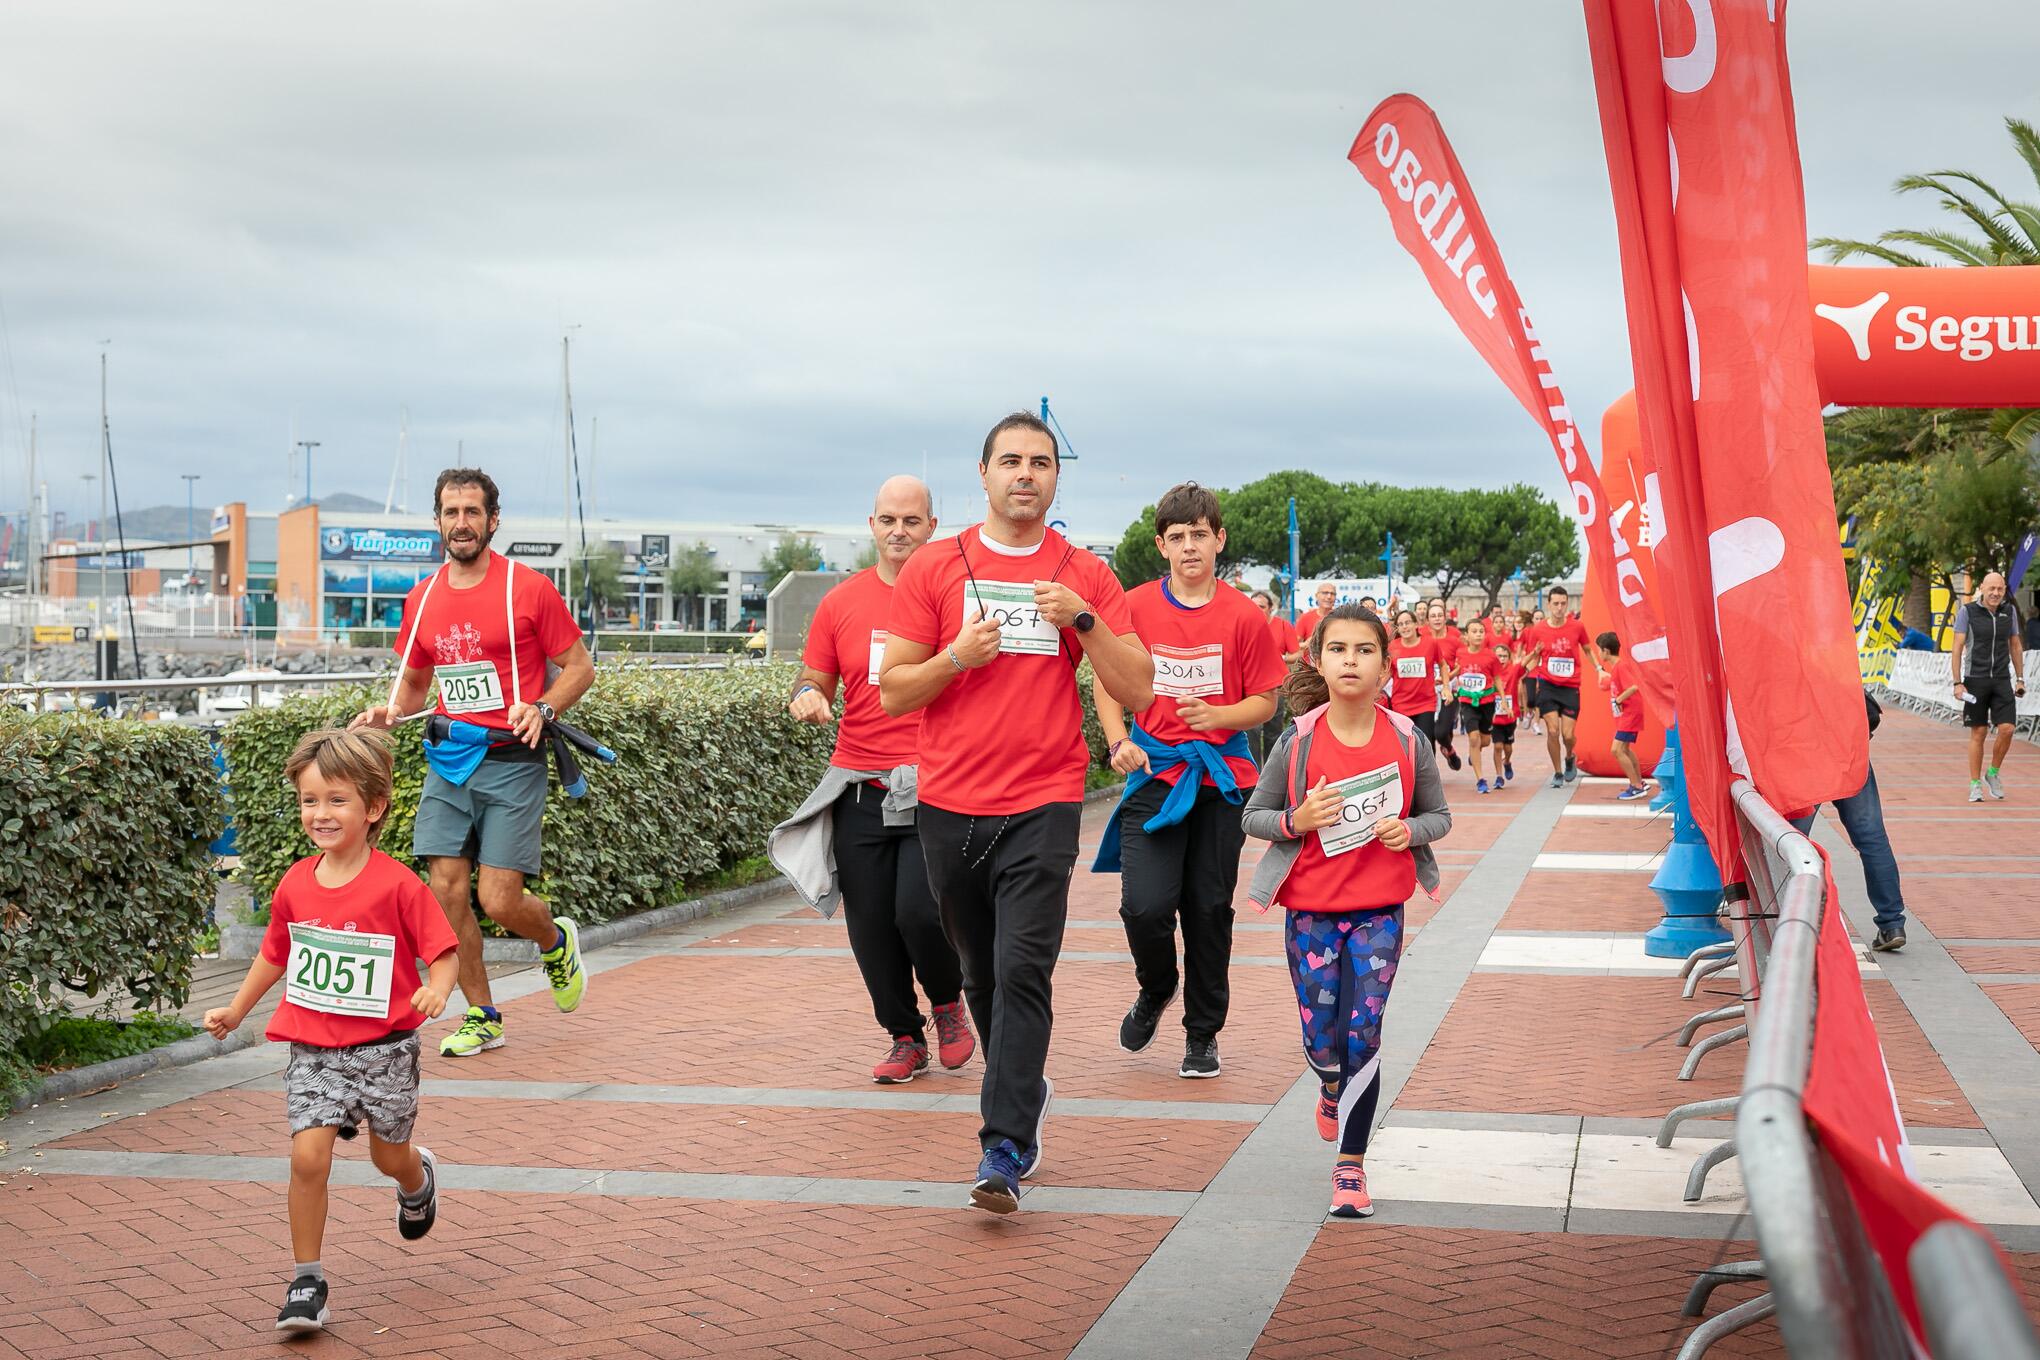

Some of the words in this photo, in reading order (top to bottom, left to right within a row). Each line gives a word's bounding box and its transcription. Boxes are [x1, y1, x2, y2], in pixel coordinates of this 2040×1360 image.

[351, 533, 433, 556] Tarpoon
[991, 607, 1041, 628] 067
[1400, 663, 1423, 675] 2017
[1551, 663, 1571, 673] 1014
[444, 675, 492, 702] 2051
[1462, 678, 1483, 689] 1014
[296, 947, 376, 996] 2051
